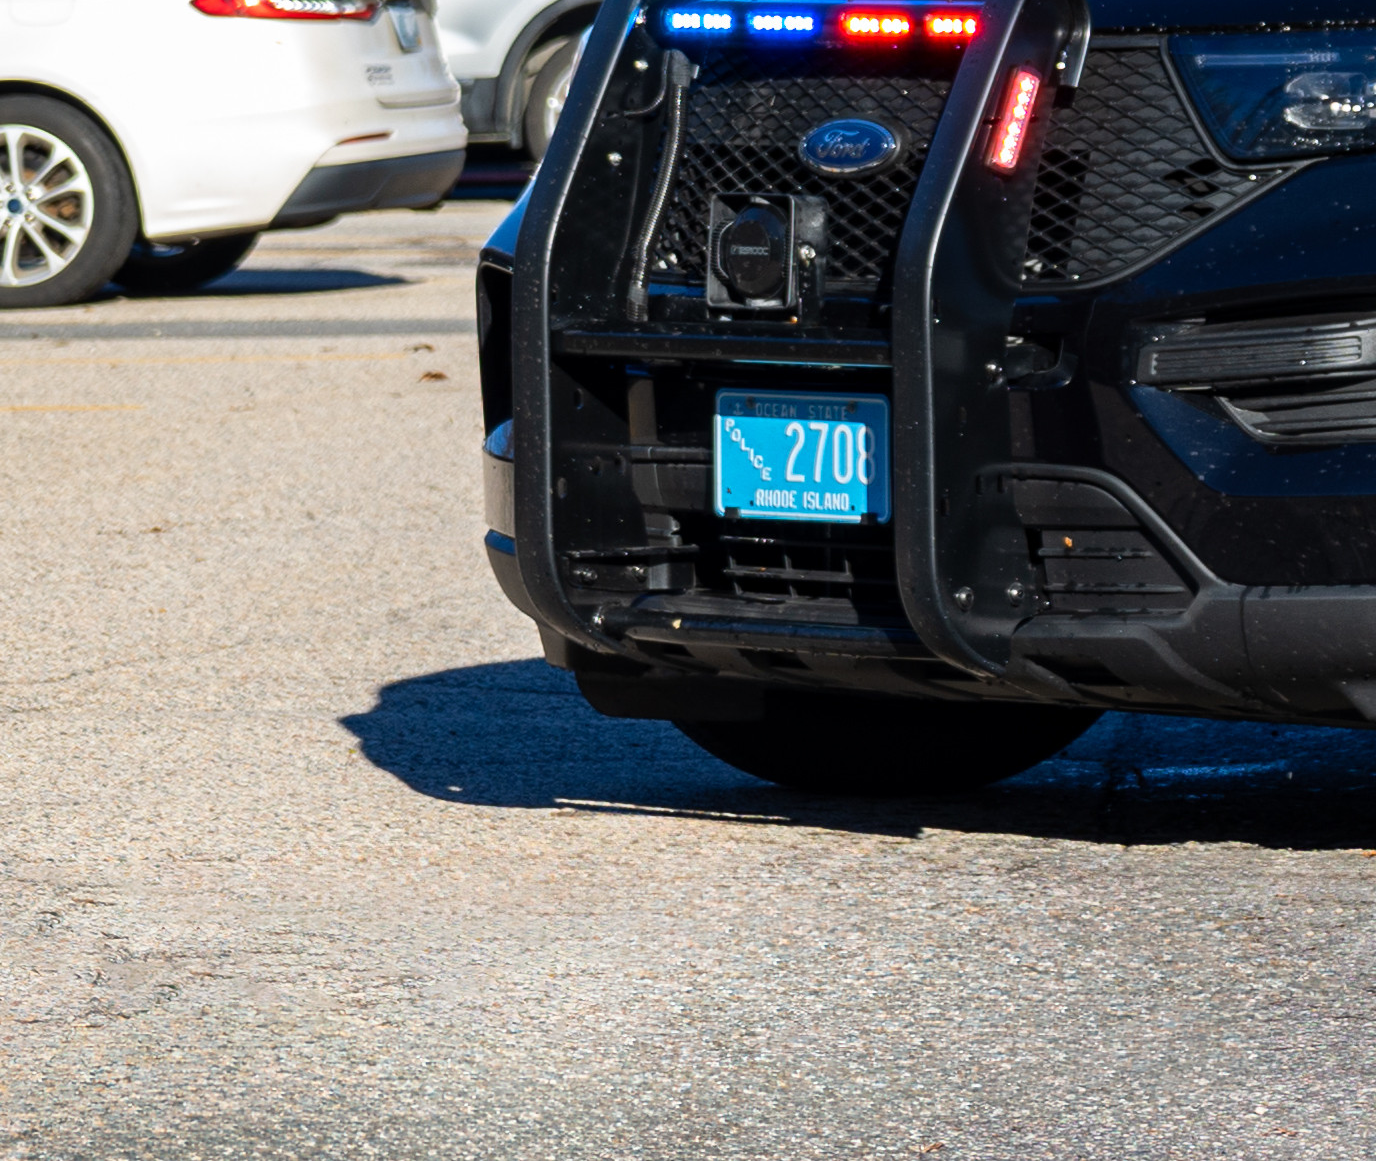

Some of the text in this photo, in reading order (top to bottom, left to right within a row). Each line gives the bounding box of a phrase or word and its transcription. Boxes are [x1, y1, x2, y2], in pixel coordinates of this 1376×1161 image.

[818, 129, 870, 158] Ford
[755, 402, 849, 421] OCEAN STATE
[724, 418, 773, 482] POLICE
[785, 421, 876, 486] 2708
[755, 489, 850, 511] RHODE ISLAND
